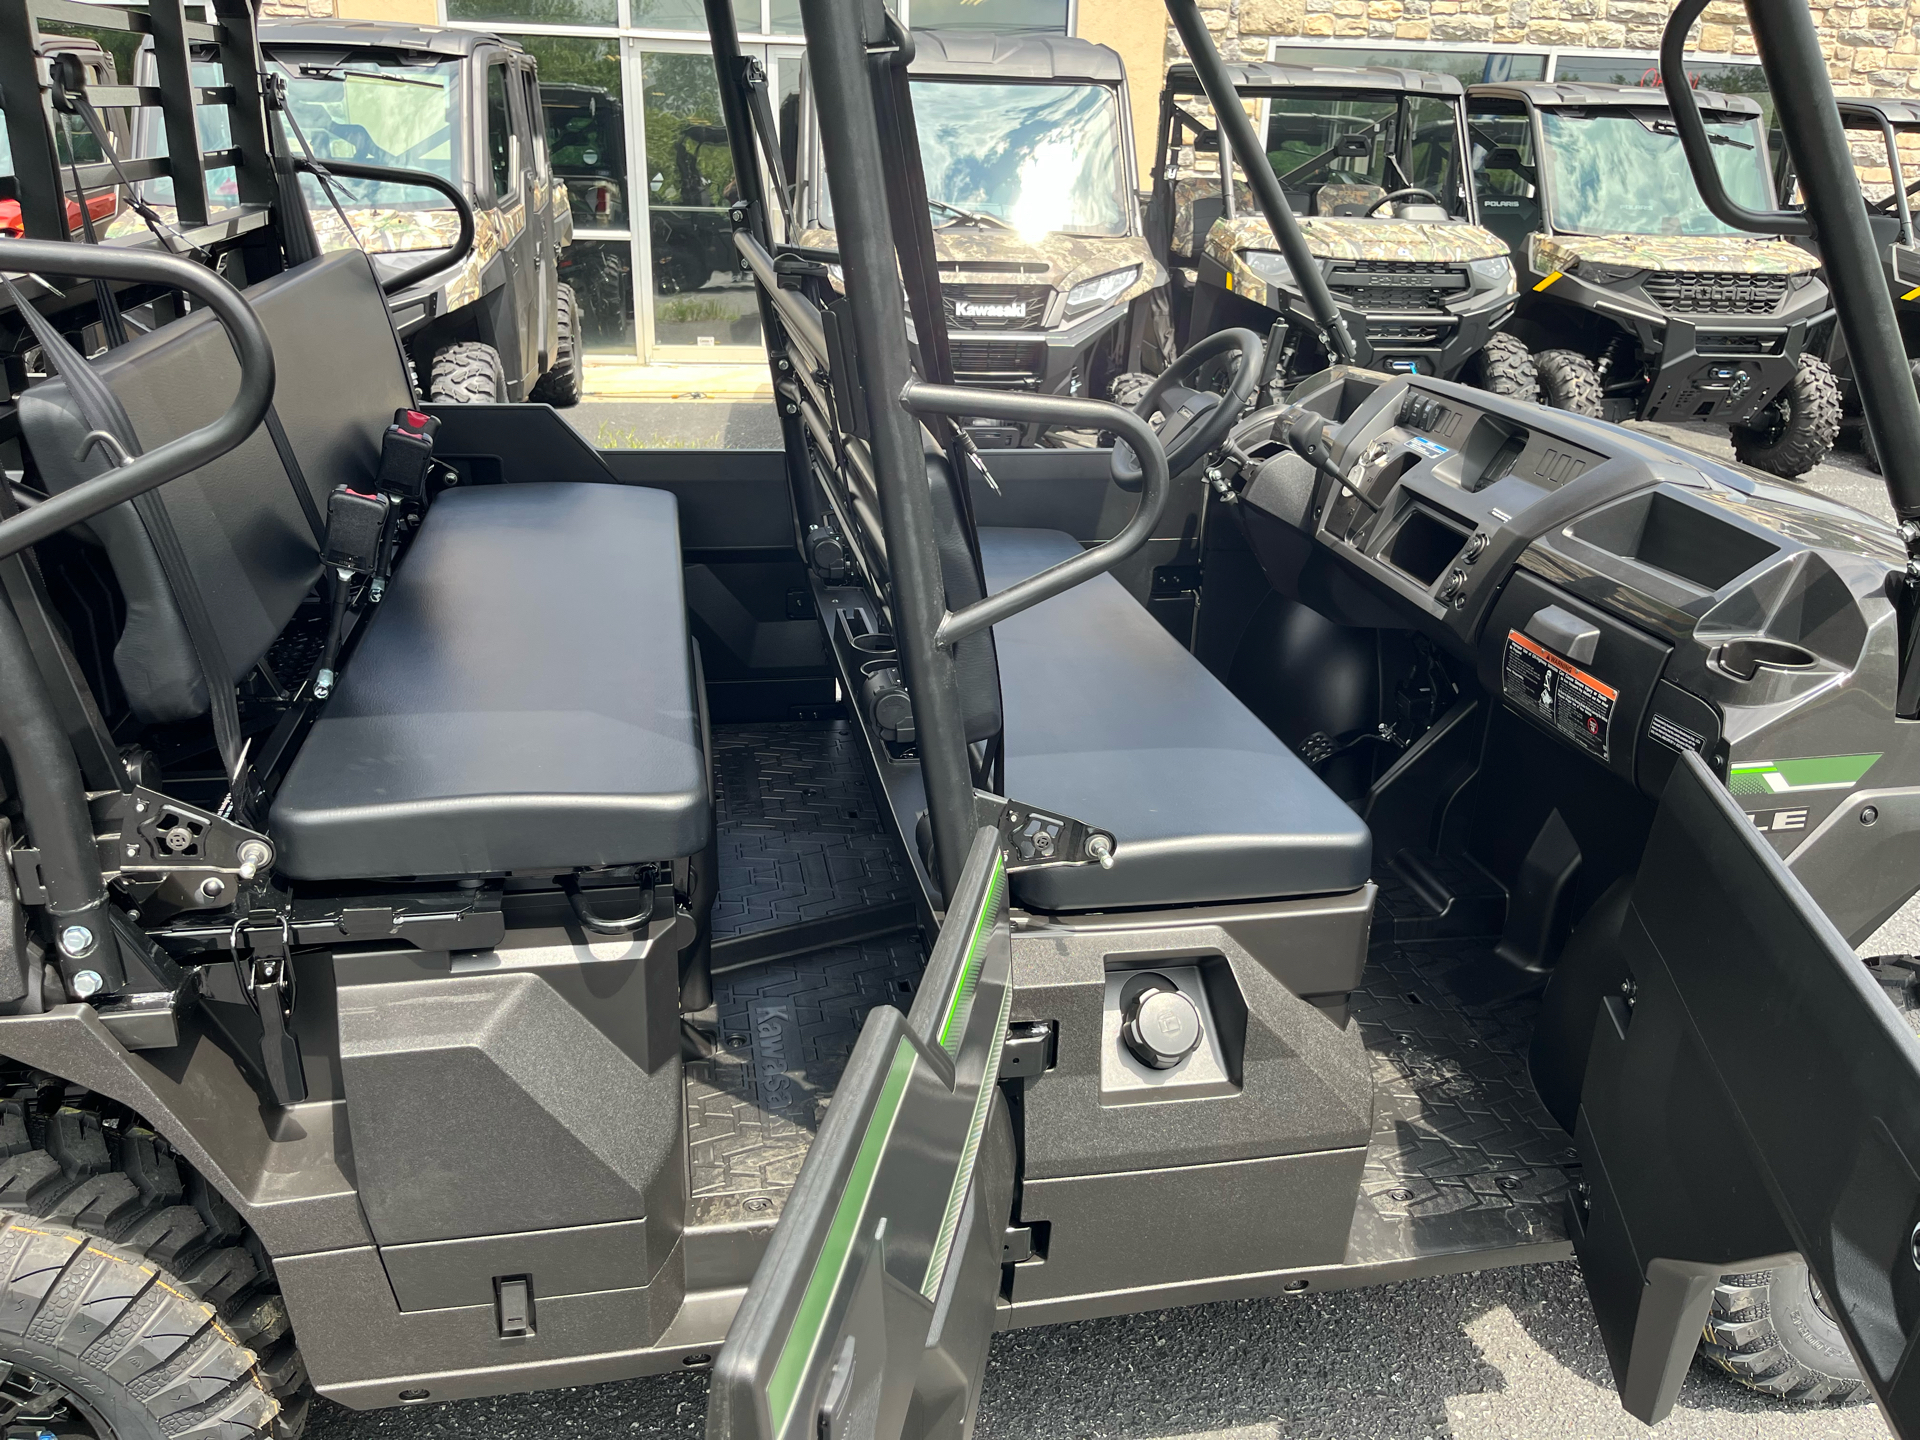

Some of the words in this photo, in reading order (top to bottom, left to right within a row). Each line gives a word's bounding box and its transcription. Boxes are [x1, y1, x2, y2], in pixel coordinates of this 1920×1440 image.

[1484, 200, 1520, 208] POLARIS
[1368, 275, 1432, 287] POLARIS
[1680, 286, 1768, 300] POLARIS
[955, 302, 1026, 317] Kawasaki
[1550, 655, 1573, 673] WARNING
